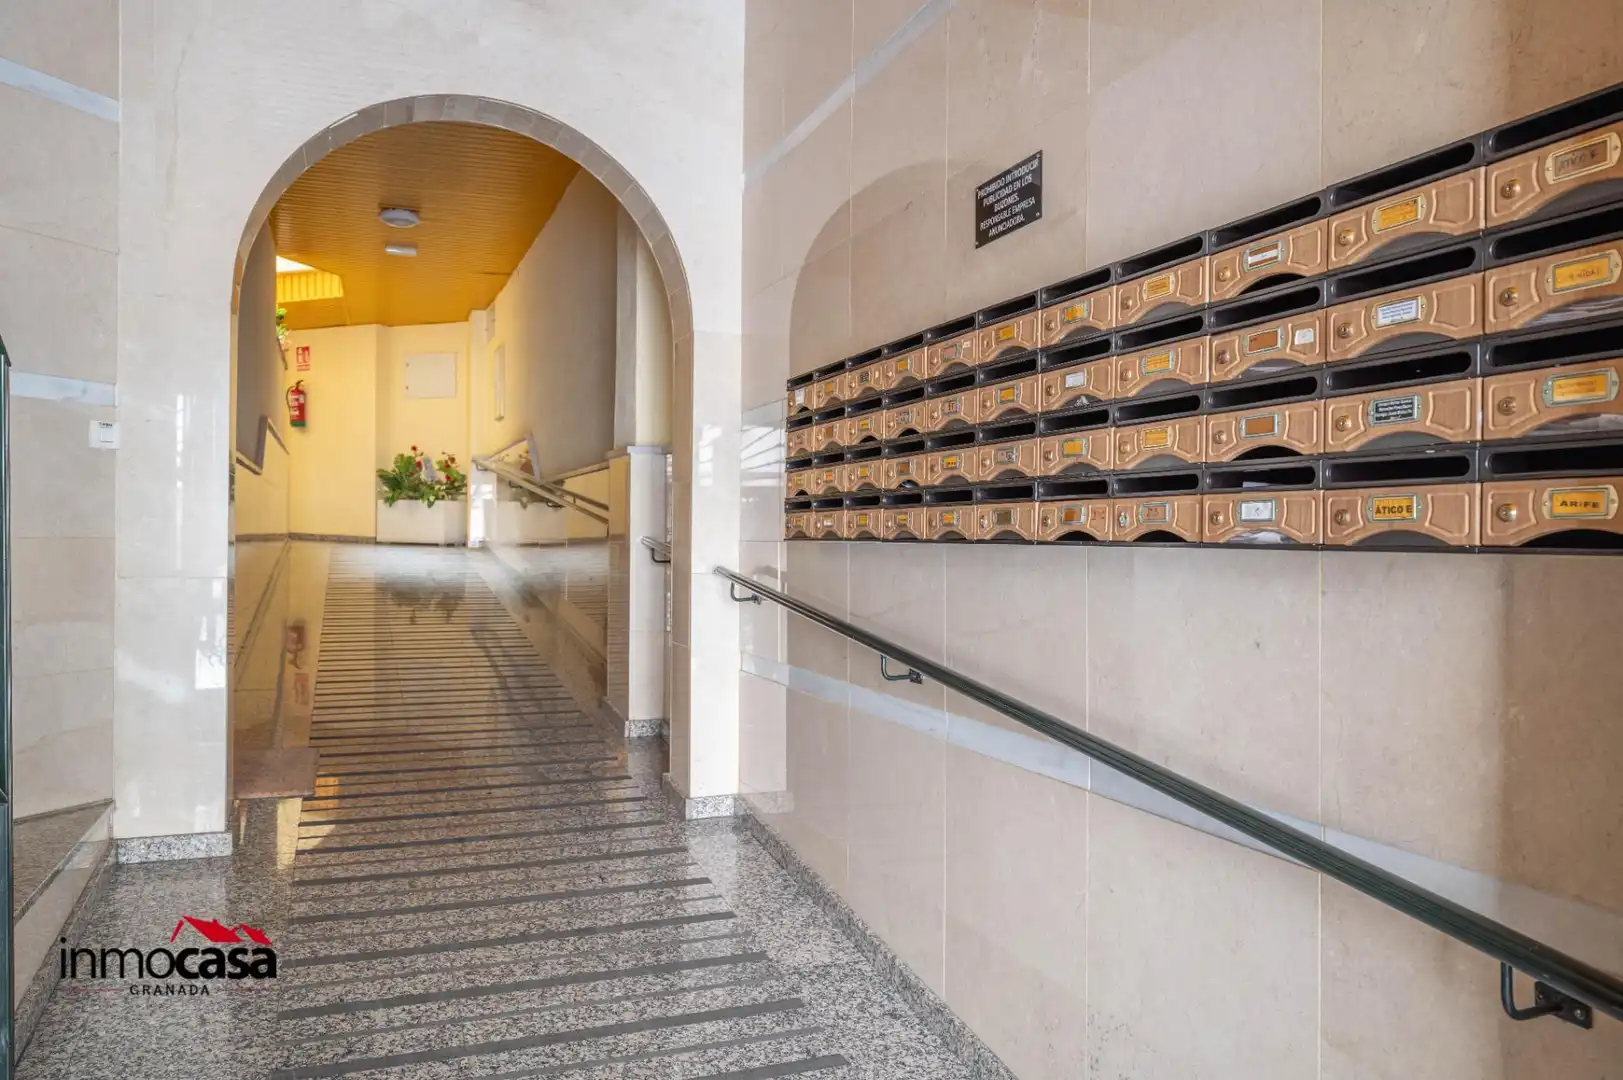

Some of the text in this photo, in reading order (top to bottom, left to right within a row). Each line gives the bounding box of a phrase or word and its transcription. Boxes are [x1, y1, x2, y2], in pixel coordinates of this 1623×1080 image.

[977, 158, 1039, 200] PROHIBIDO INTRODUCIR
[983, 173, 1033, 207] PUBLICIDAD EN LOS
[980, 196, 1036, 231] RESPONSABLE EMPRESA
